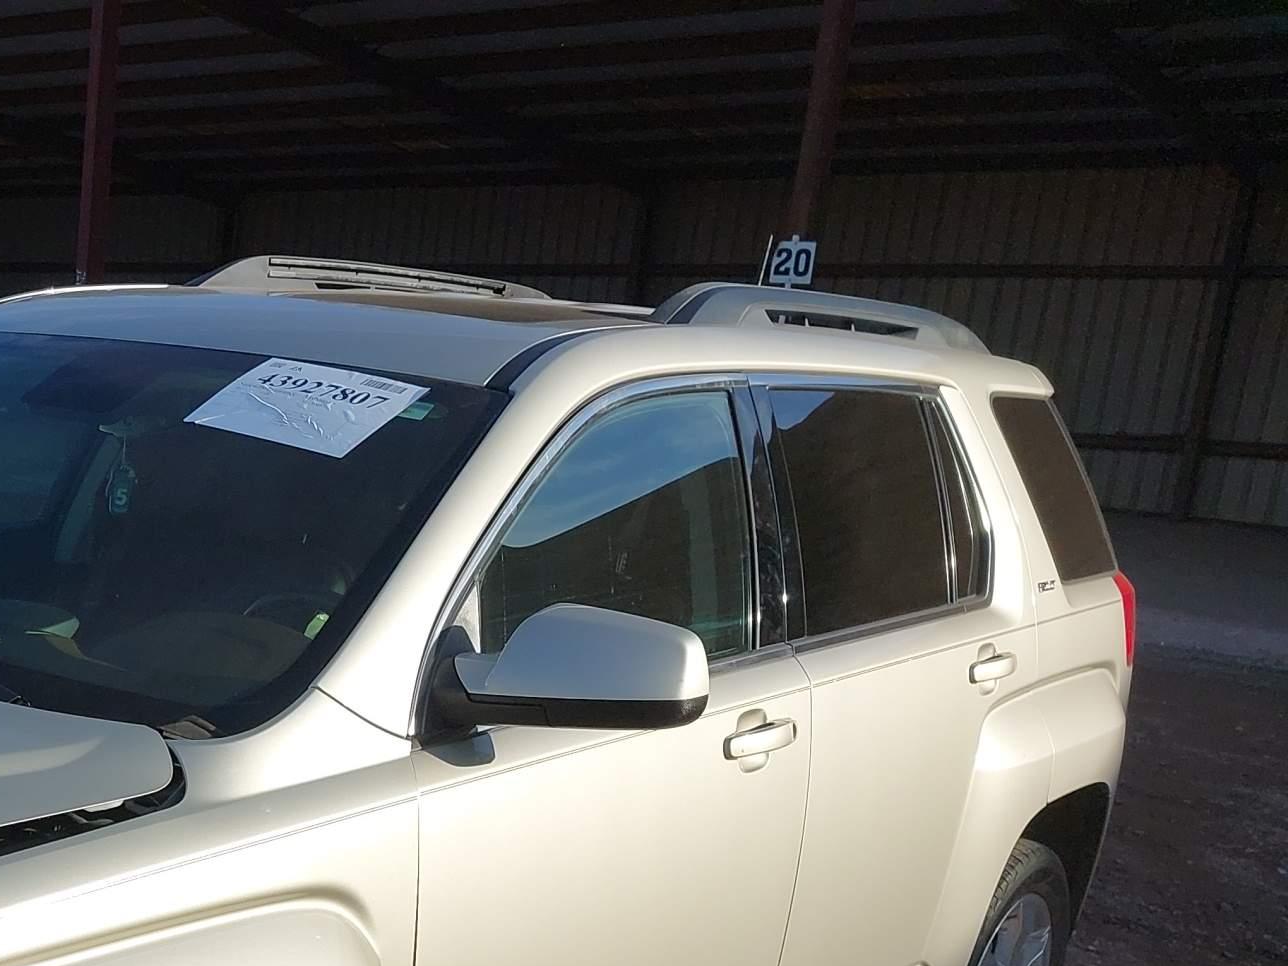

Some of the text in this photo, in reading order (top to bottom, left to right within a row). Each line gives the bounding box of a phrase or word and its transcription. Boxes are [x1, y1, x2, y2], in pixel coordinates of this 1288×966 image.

[772, 247, 812, 278] 20
[256, 372, 392, 410] 43927807
[114, 488, 127, 505] 5
